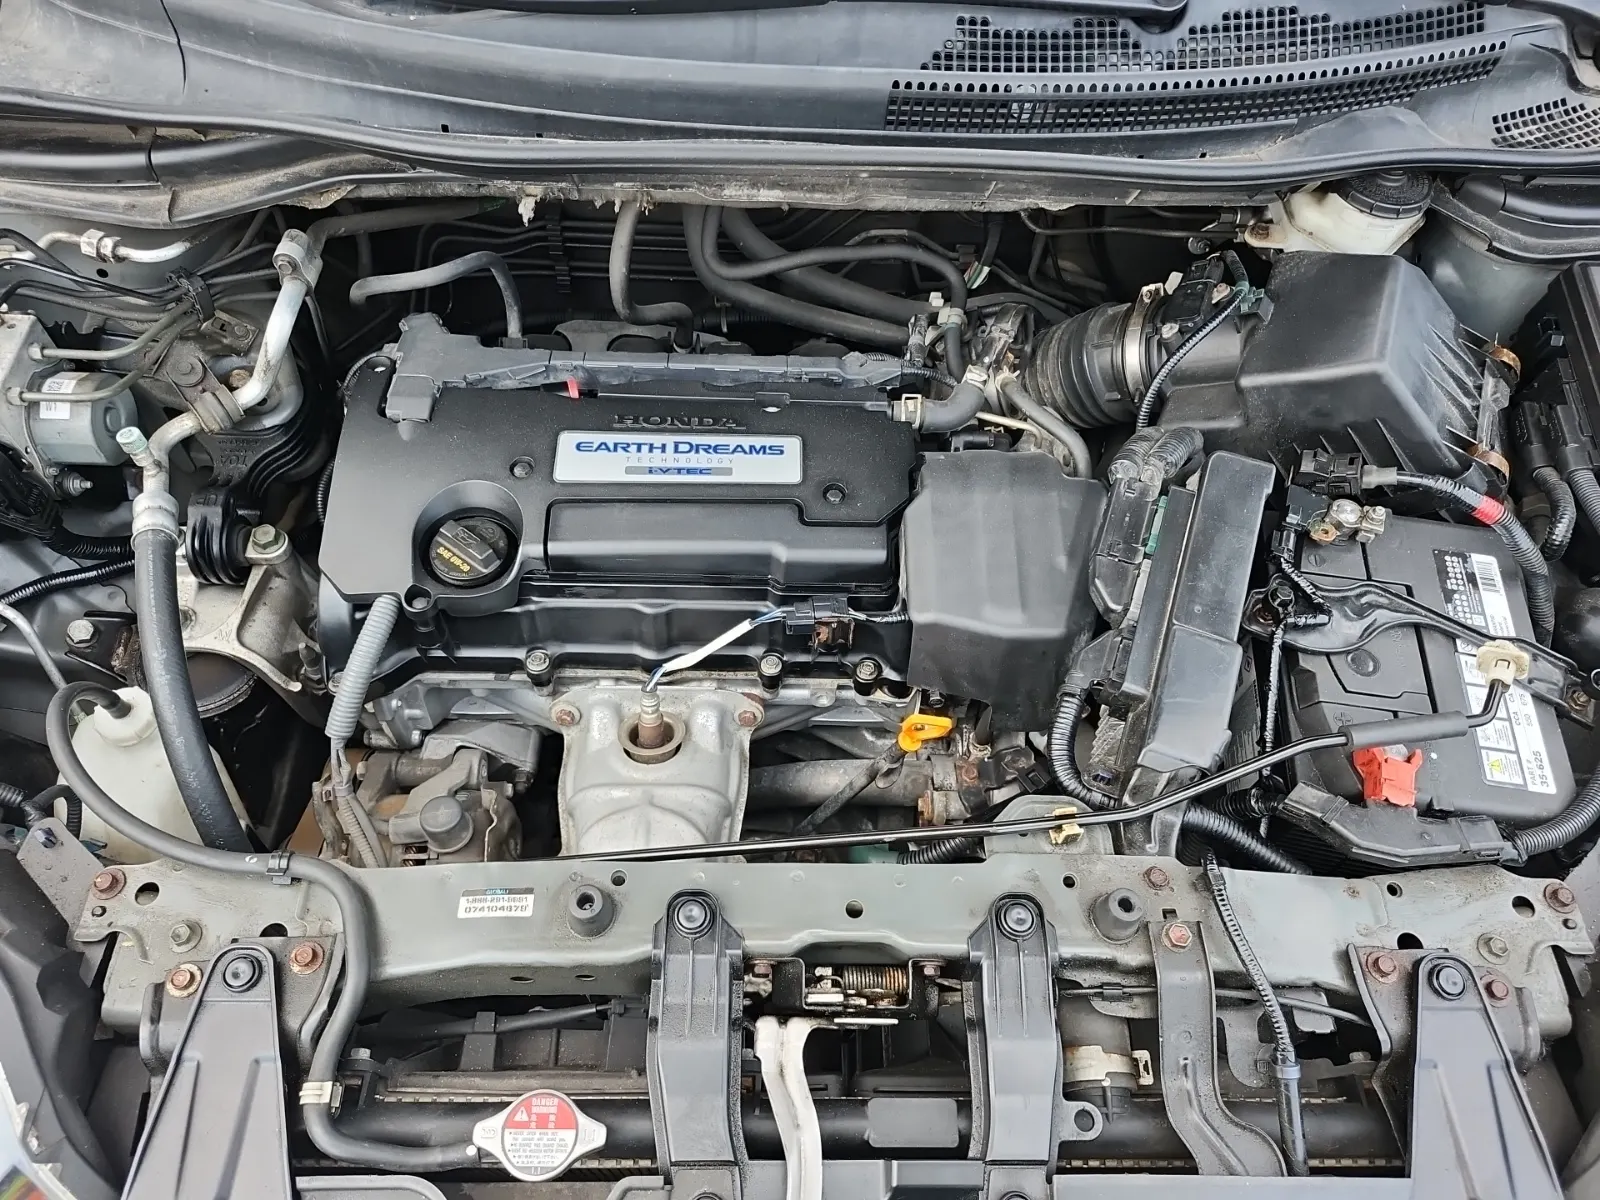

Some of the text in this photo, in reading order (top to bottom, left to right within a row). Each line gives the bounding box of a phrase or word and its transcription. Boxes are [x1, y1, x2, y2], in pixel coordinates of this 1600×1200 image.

[612, 413, 747, 429] HONDA
[575, 441, 667, 454] EARTH
[626, 457, 734, 465] TECHNOLOGY
[436, 546, 454, 560] SAE
[449, 555, 471, 573] 0W-20
[1508, 693, 1521, 726] CCA CA
[1527, 766, 1538, 786] PART
[1533, 750, 1549, 788] 35-625
[531, 1097, 559, 1106] DANGER
